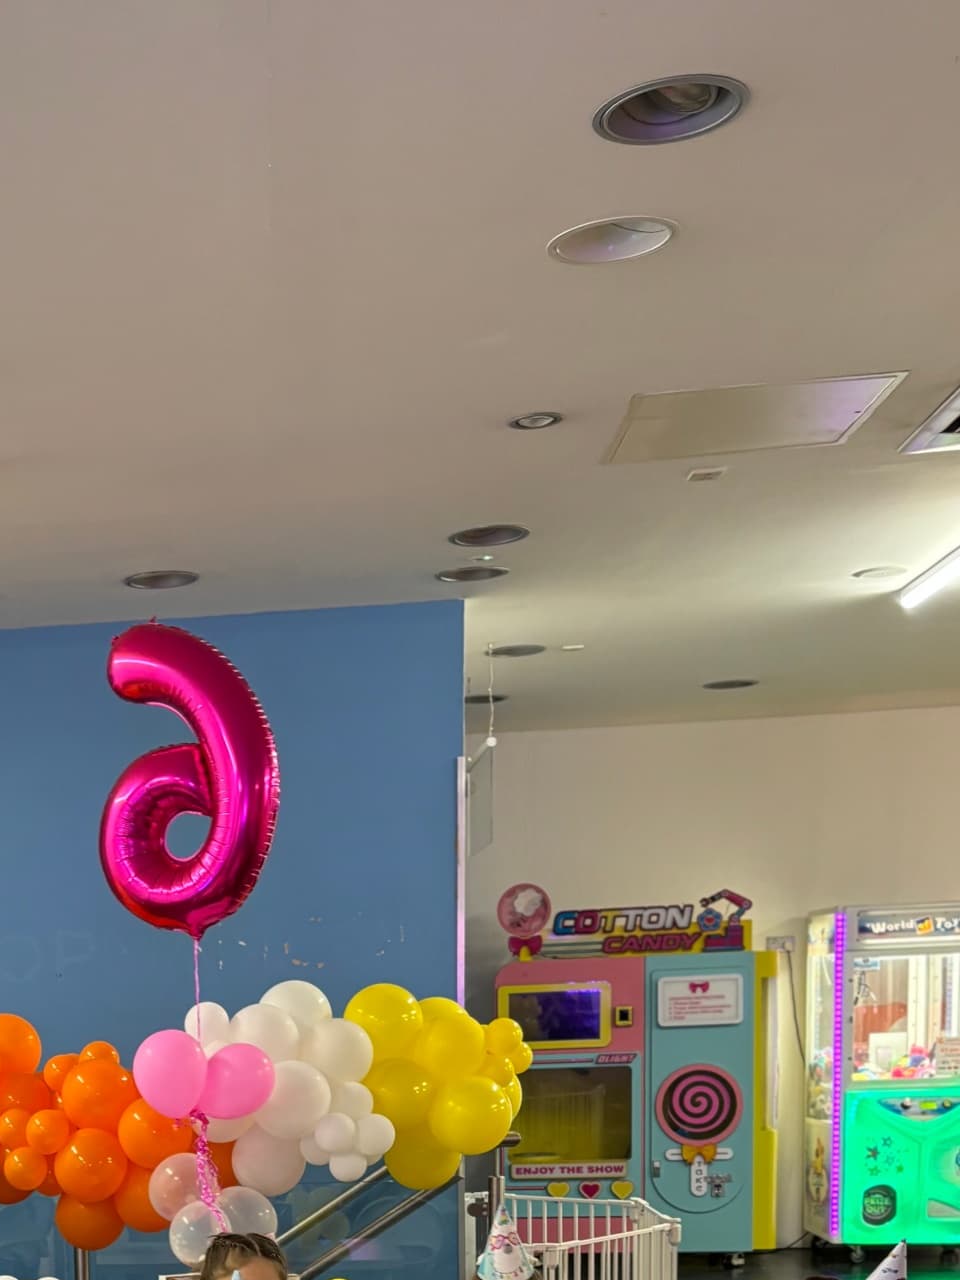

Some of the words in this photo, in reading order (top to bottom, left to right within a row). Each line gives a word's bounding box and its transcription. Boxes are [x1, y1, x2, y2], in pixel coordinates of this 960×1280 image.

[554, 905, 693, 936] COTTON
[602, 932, 702, 954] CANDY
[515, 1167, 556, 1176] ENJOY
[559, 1165, 585, 1175] THE
[587, 1164, 625, 1174] SHOW
